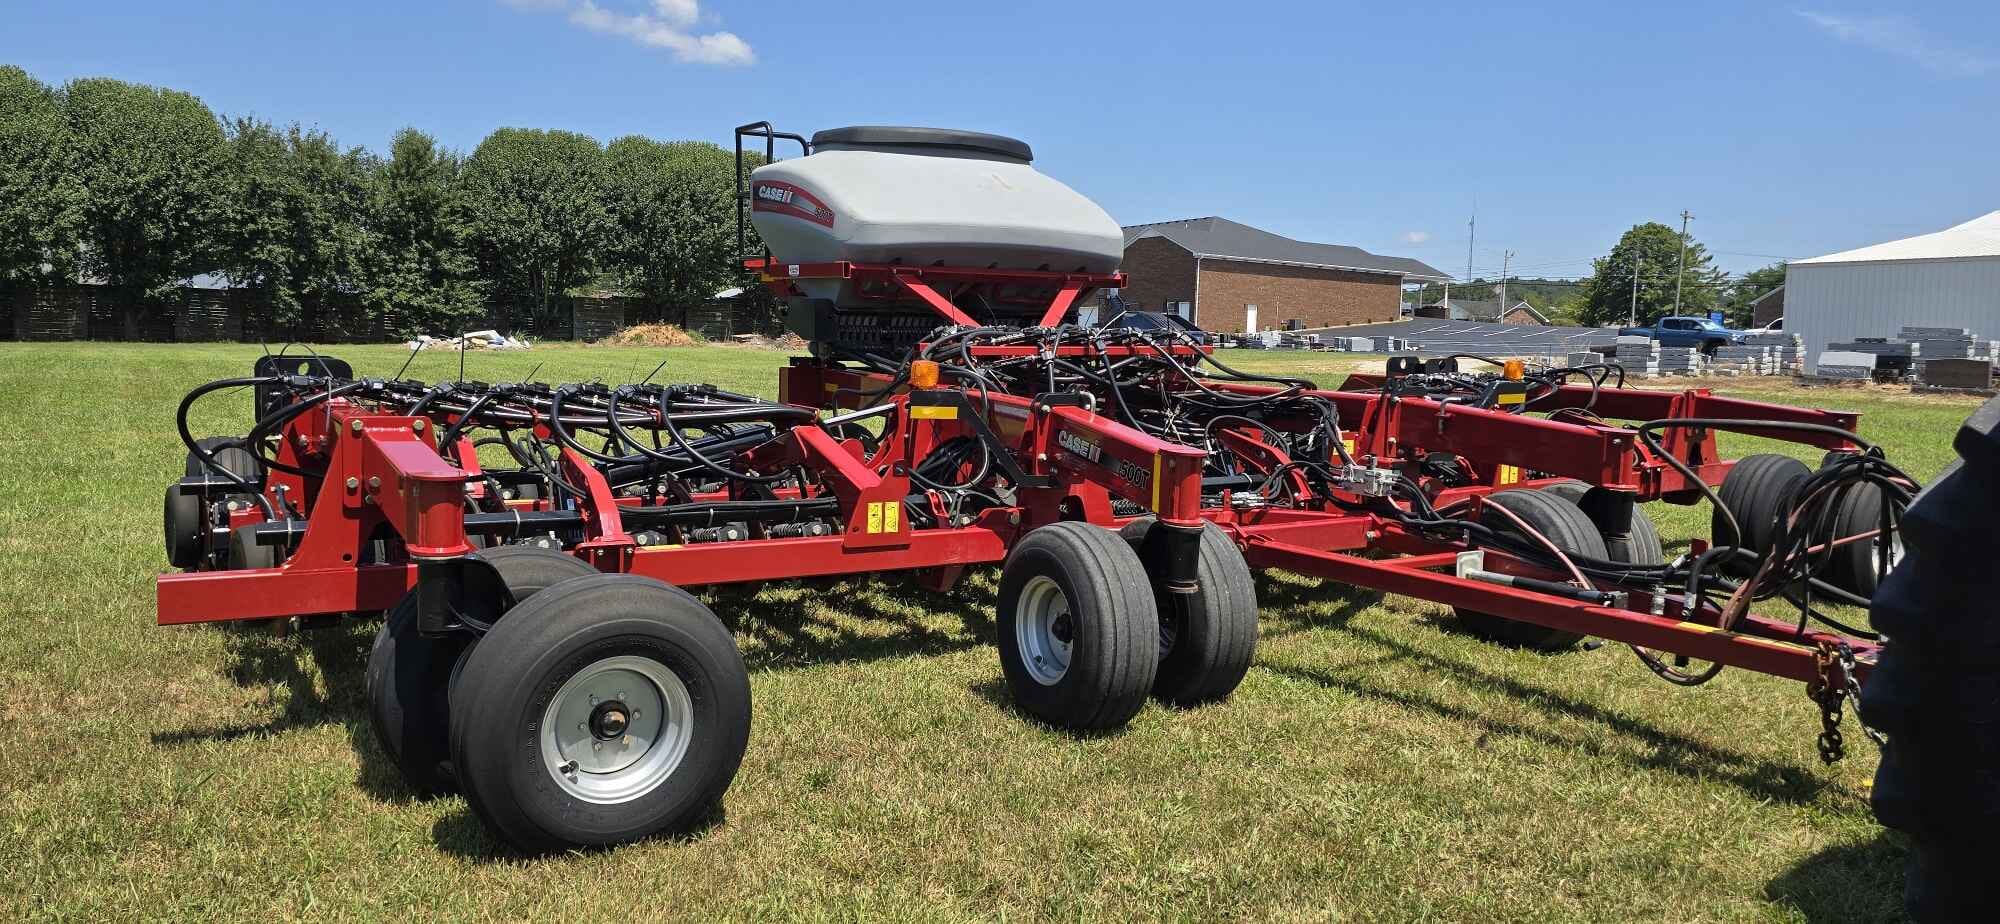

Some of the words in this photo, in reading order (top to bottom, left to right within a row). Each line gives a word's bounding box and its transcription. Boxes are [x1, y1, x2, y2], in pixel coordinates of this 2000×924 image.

[759, 186, 783, 202] CASE
[1058, 430, 1089, 456] CASE
[1119, 459, 1151, 489] 500T
